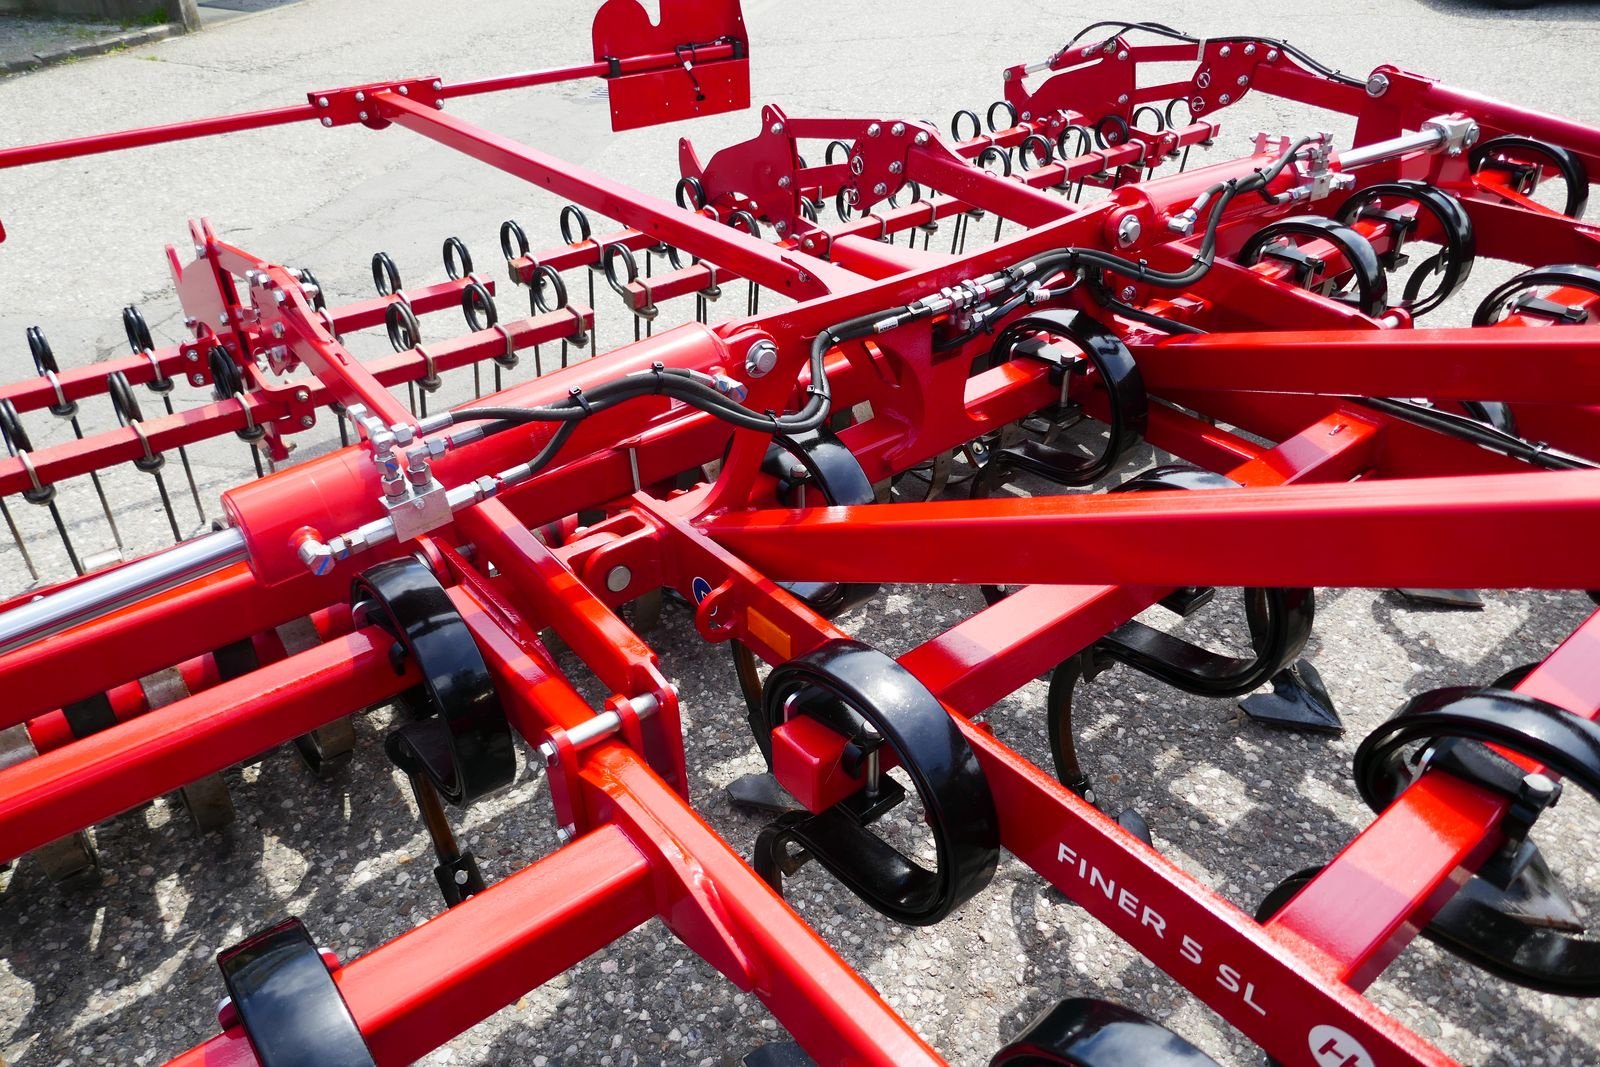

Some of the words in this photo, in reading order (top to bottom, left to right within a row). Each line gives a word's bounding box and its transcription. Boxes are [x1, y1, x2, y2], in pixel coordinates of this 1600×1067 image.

[1057, 842, 1166, 939] FINER
[1179, 934, 1203, 964] 5
[1216, 963, 1266, 1016] SL
